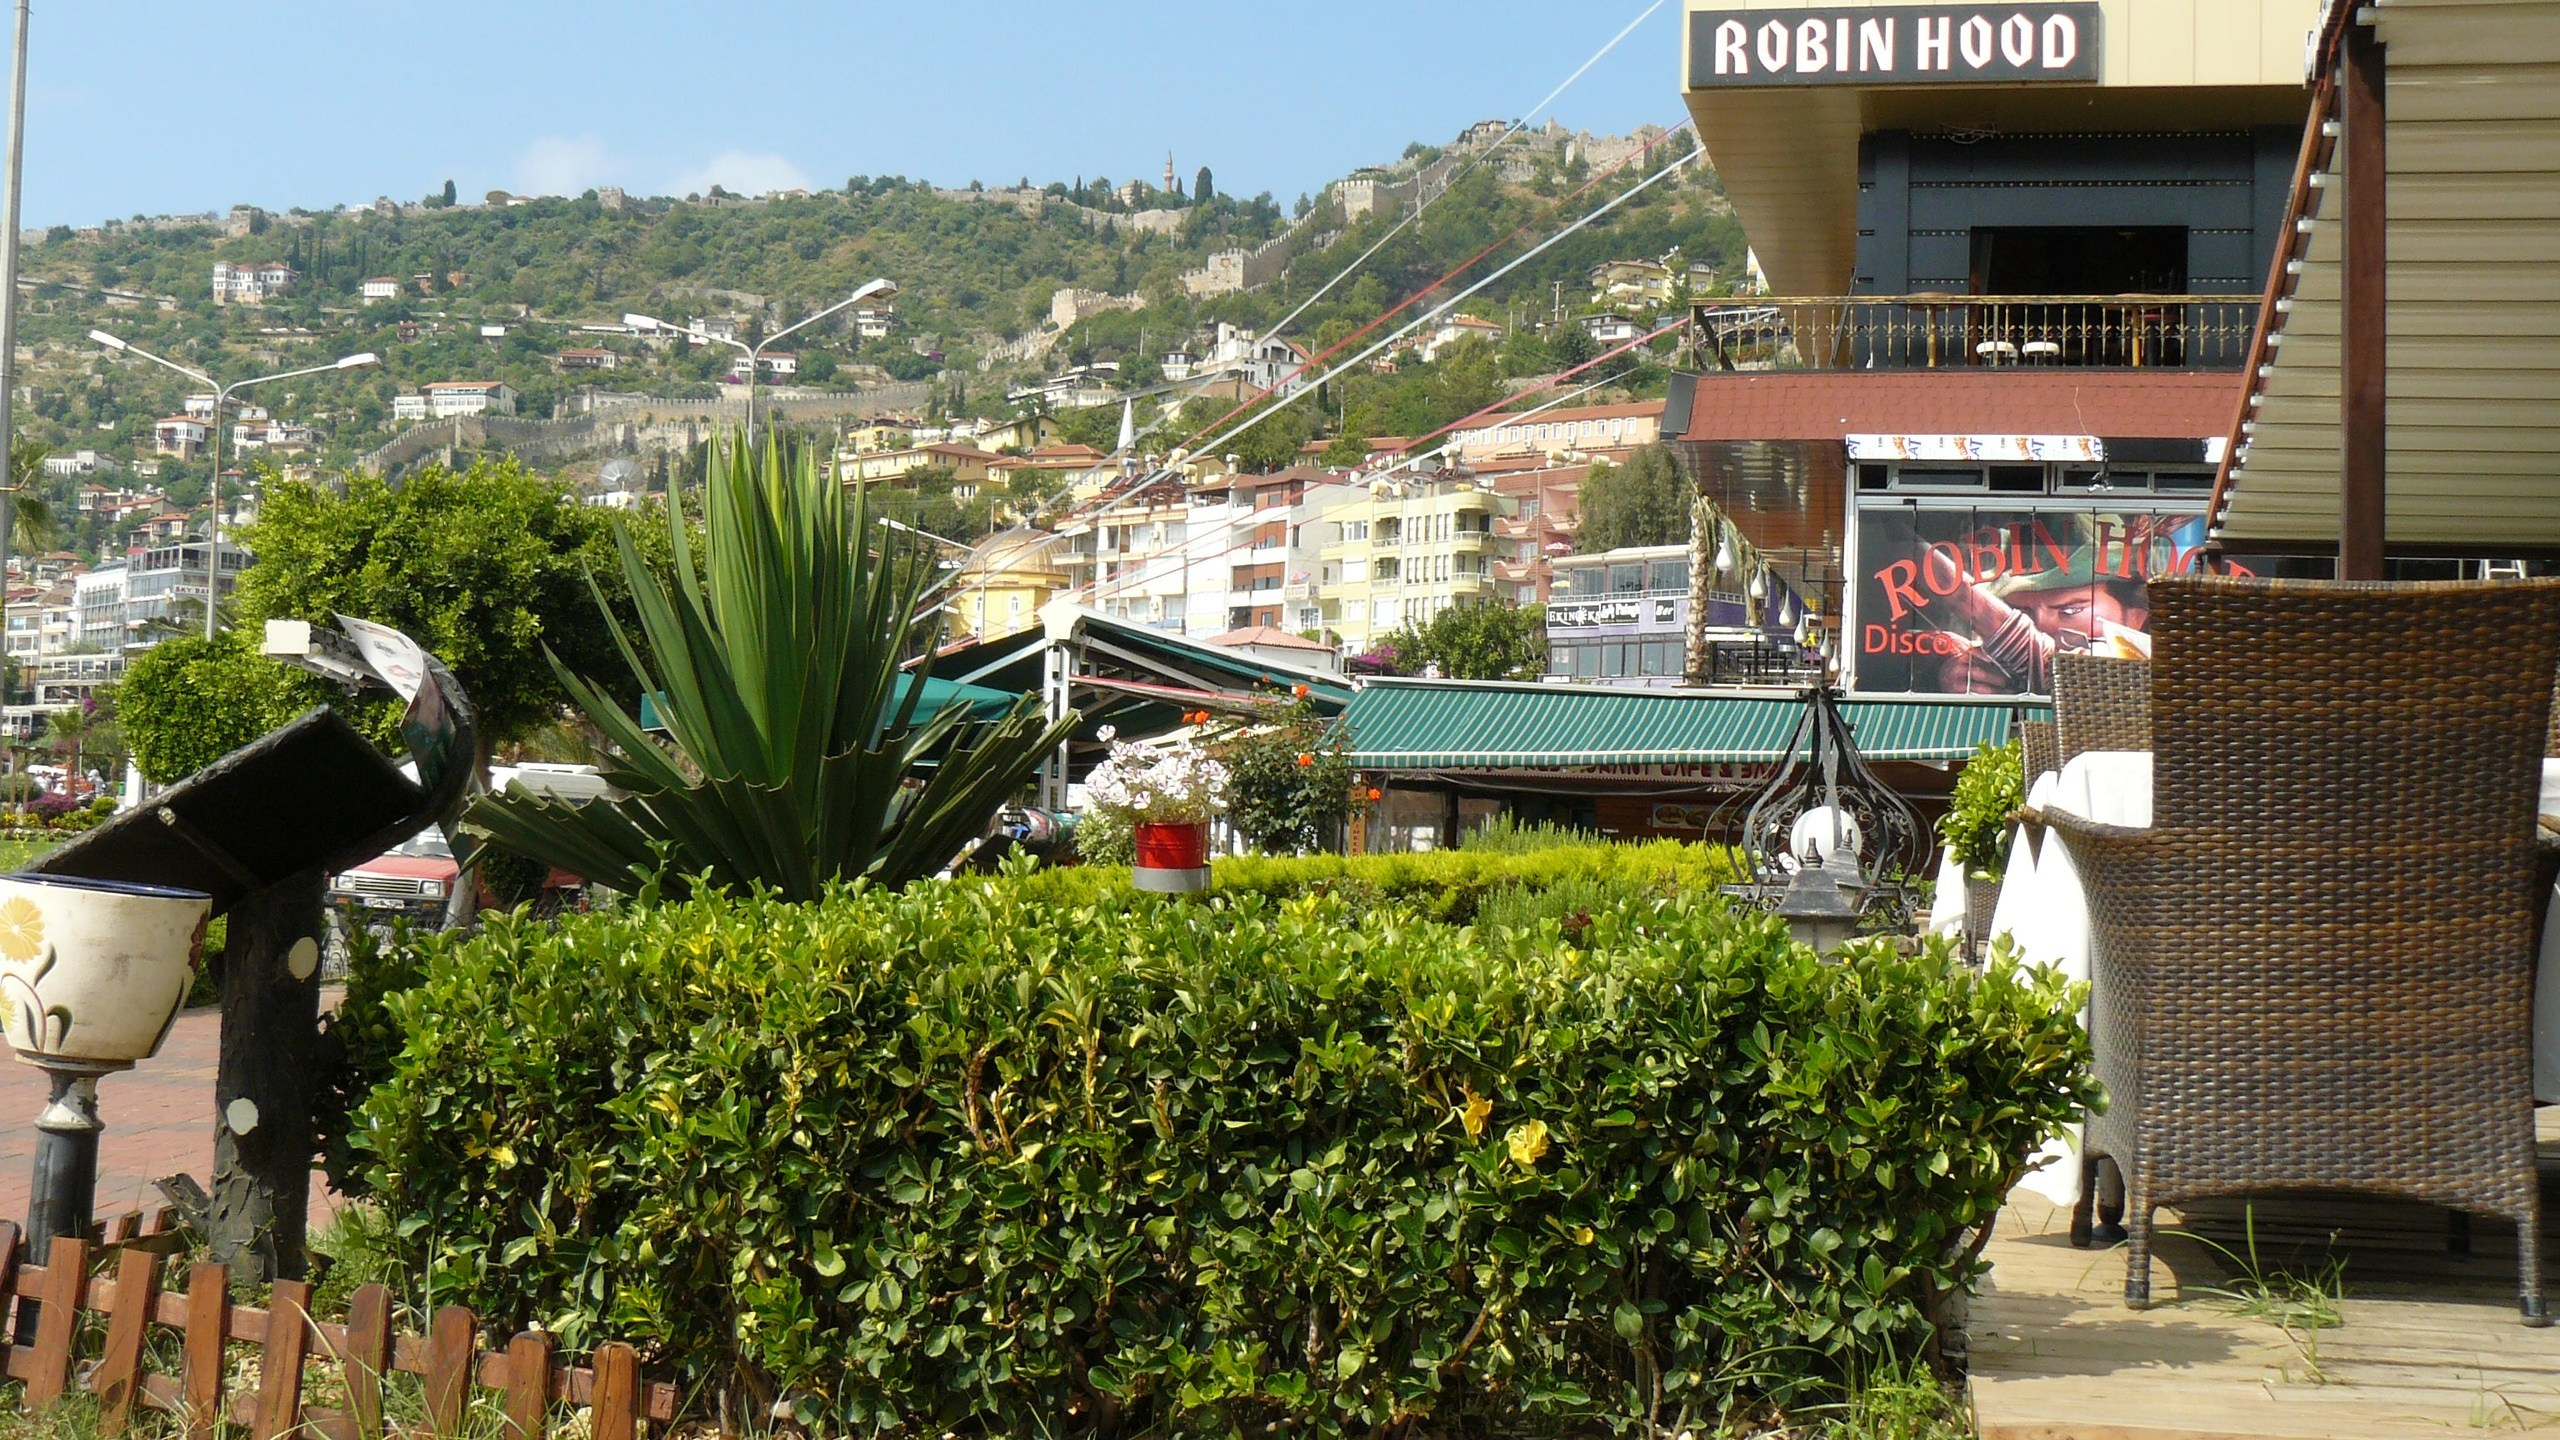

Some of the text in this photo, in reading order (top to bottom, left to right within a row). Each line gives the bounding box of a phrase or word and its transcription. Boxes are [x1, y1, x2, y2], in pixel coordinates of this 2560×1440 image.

[1715, 13, 2077, 75] ROBIN HOOD
[1874, 519, 2257, 622] ROBIN HO
[1864, 624, 1951, 655] Disco
